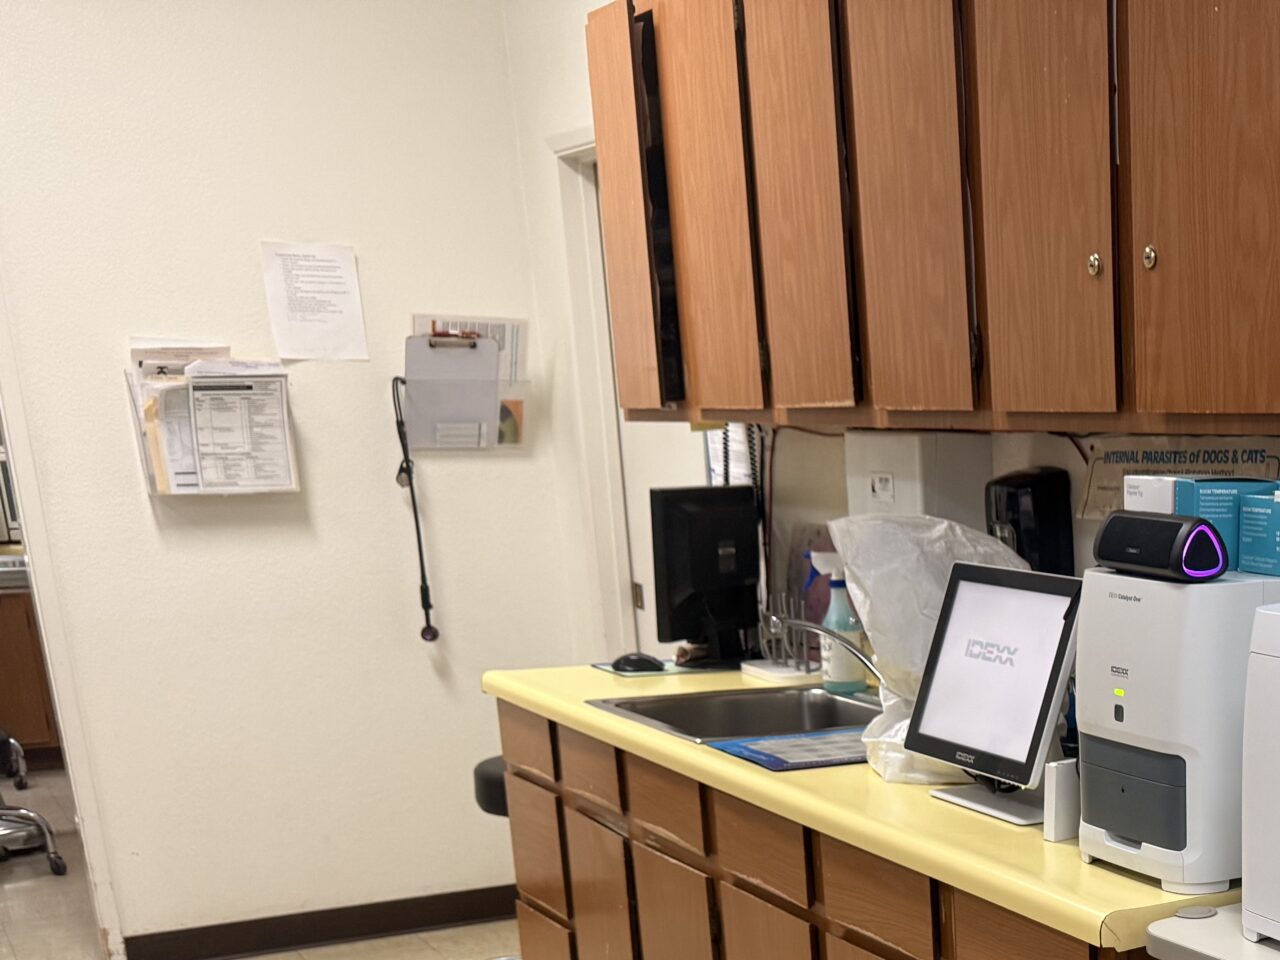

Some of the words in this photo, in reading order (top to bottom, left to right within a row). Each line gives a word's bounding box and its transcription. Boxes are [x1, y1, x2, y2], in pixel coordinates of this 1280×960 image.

[1104, 450, 1139, 464] INTERNAL
[1141, 450, 1186, 464] PARASITES
[1189, 450, 1200, 464] of
[1200, 450, 1229, 464] DOGS
[1231, 450, 1239, 464] &
[1241, 451, 1266, 464] CATS
[1118, 593, 1133, 602] Catalyst
[965, 639, 1018, 667] IDEXX
[1111, 665, 1129, 676] IDEXX
[955, 751, 975, 764] IDEXX
